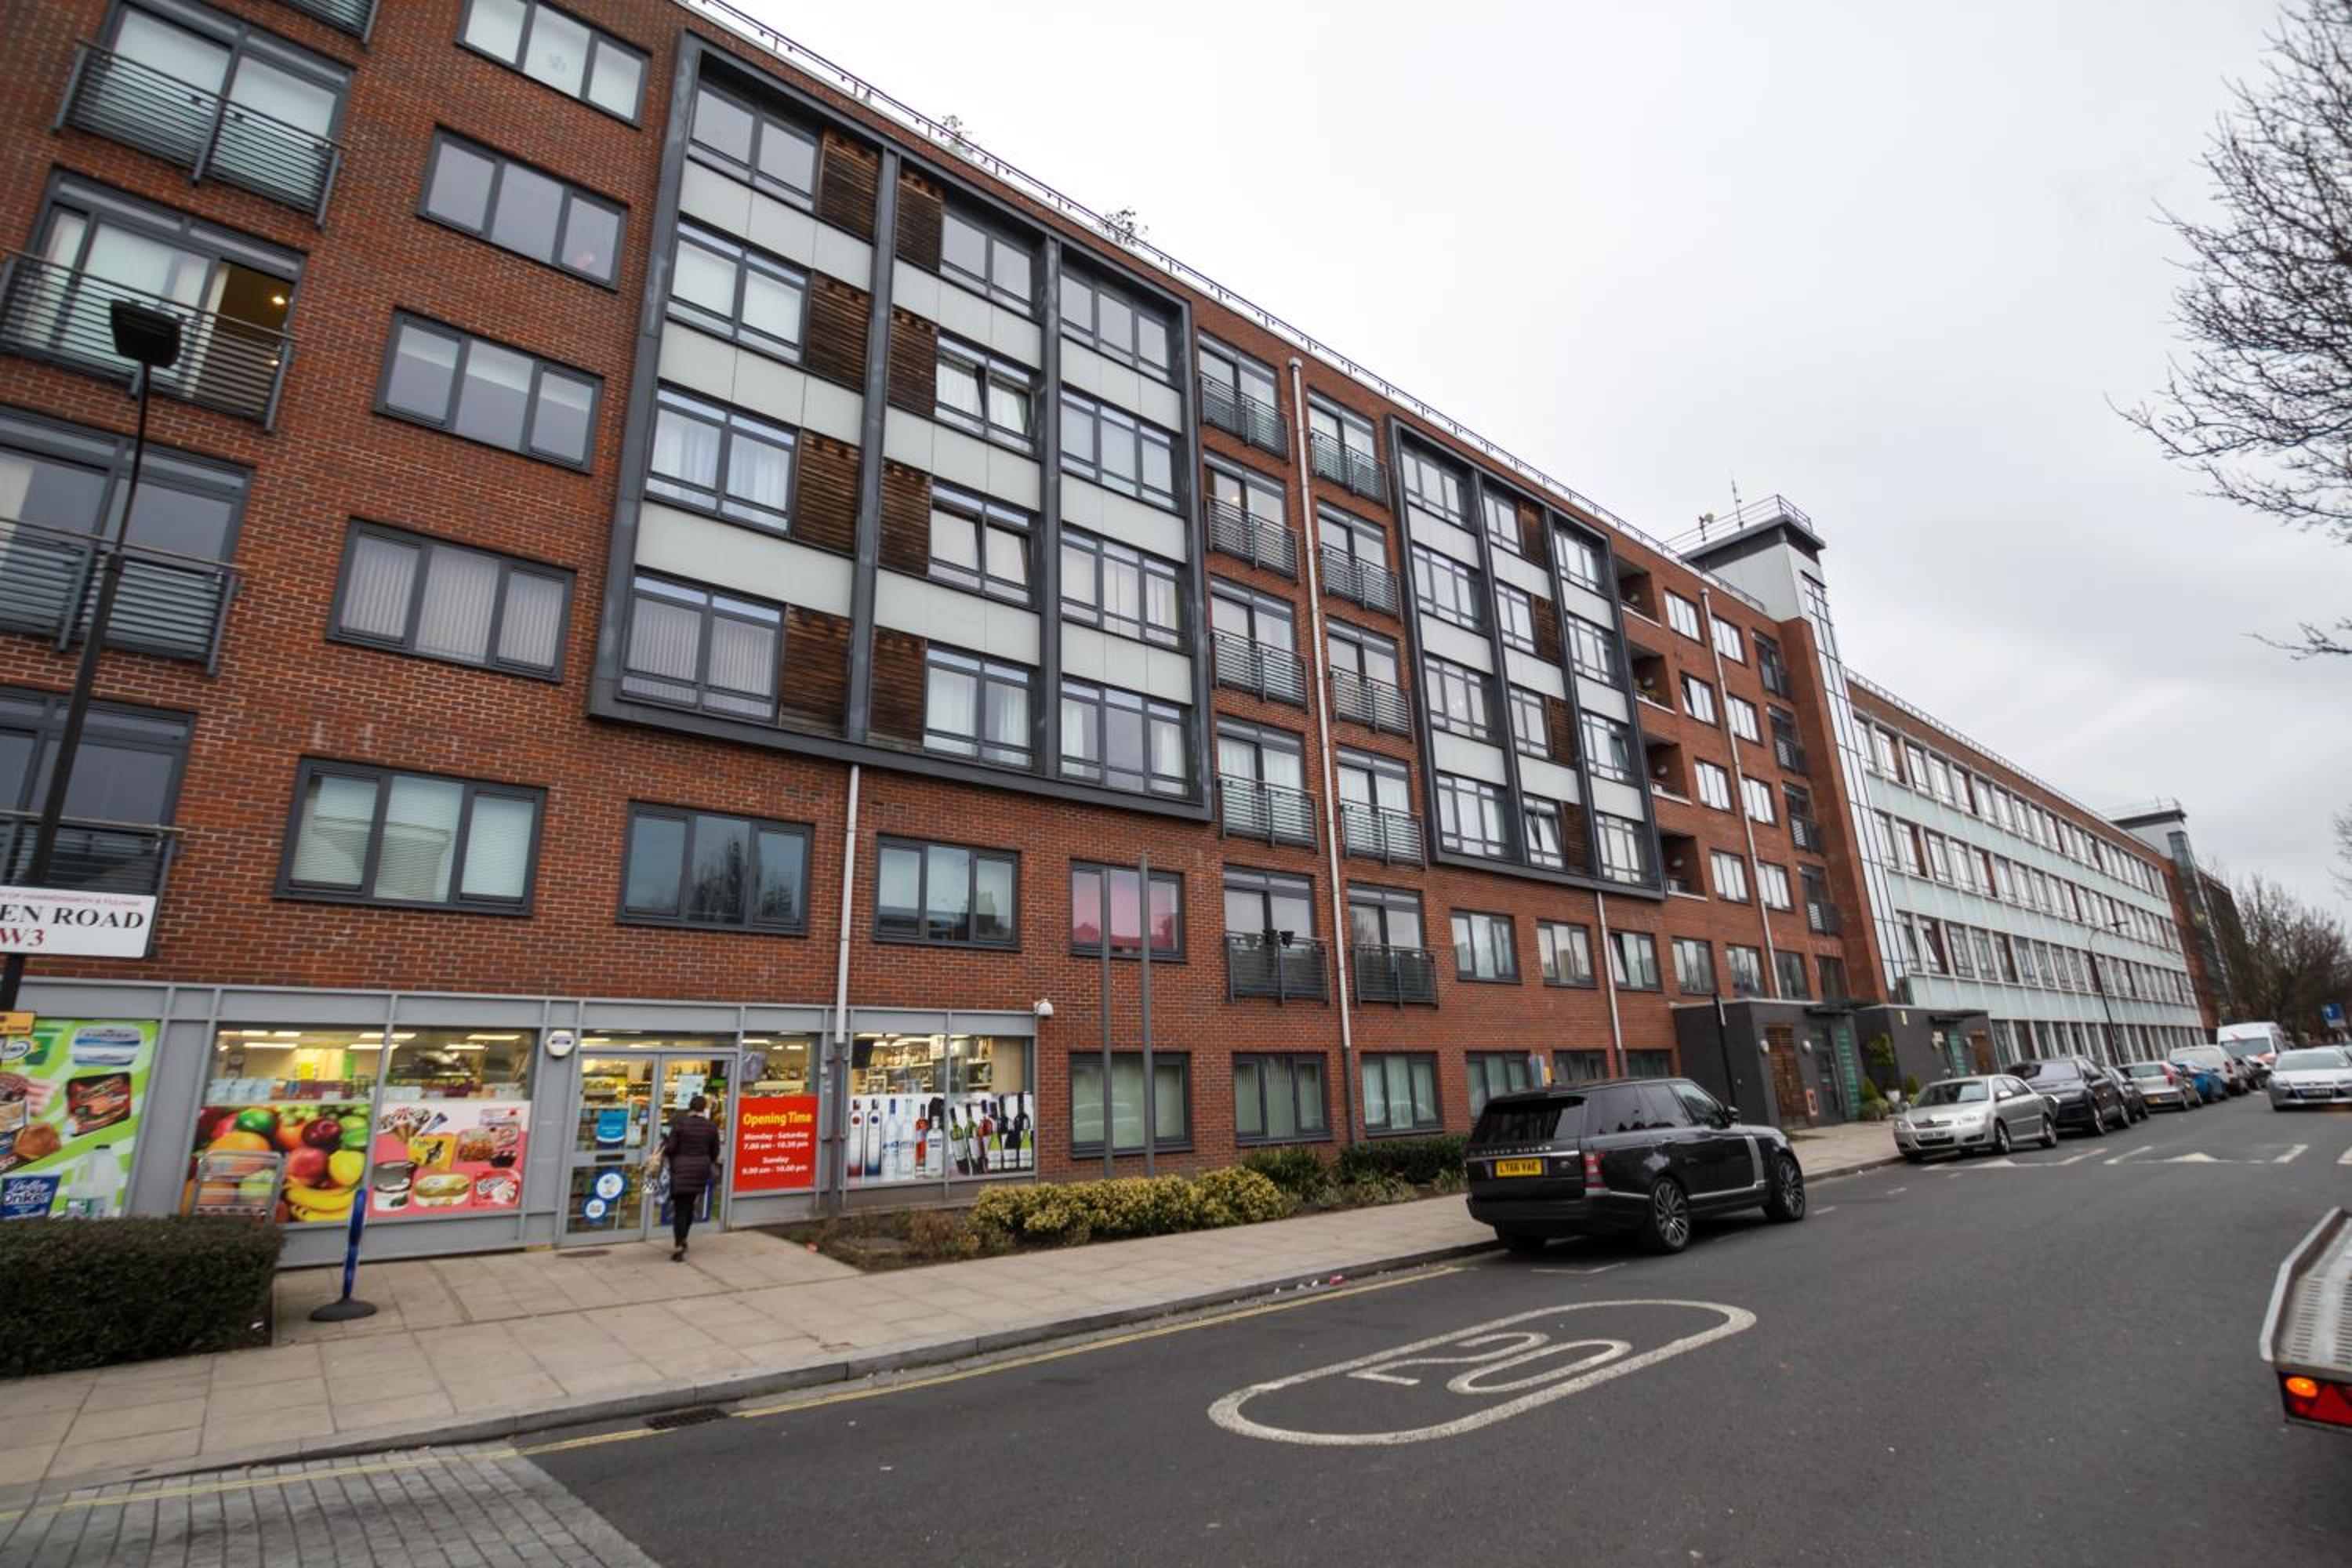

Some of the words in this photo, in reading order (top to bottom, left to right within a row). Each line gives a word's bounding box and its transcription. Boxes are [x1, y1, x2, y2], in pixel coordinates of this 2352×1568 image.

[52, 907, 144, 929] ROAD
[742, 1112, 787, 1127] Opening
[788, 1110, 812, 1123] Time
[744, 1133, 773, 1142] Monday
[777, 1131, 810, 1140] Saturday
[761, 1156, 790, 1164] Sunday
[1346, 1331, 1632, 1394] 20
